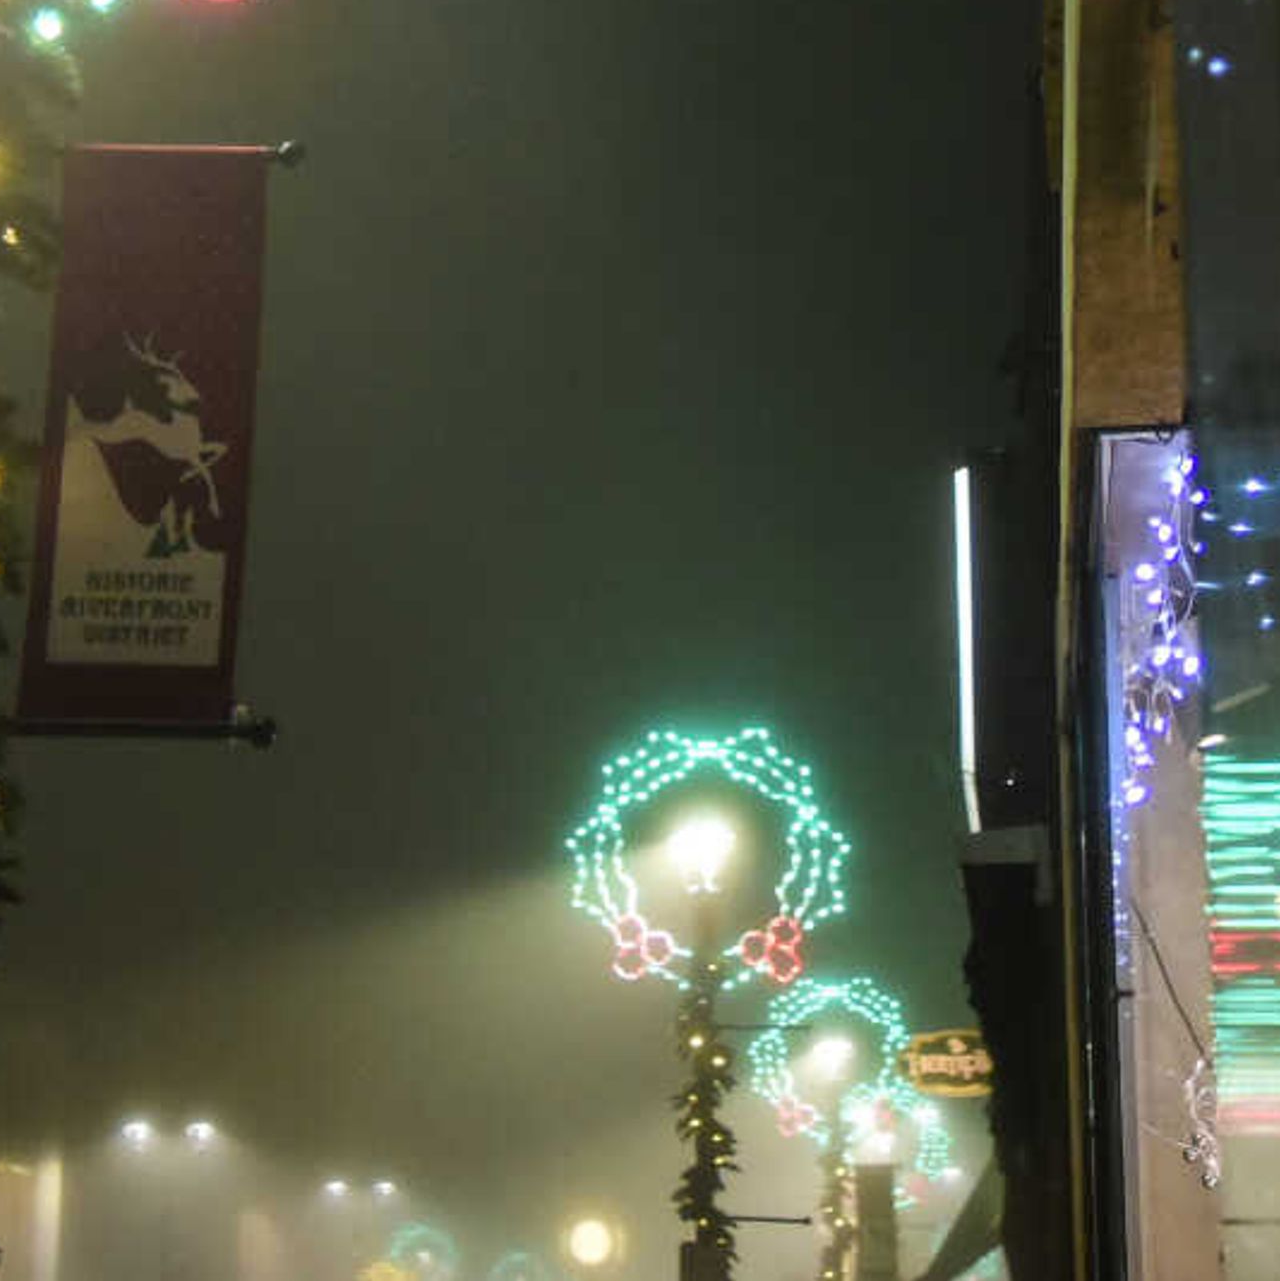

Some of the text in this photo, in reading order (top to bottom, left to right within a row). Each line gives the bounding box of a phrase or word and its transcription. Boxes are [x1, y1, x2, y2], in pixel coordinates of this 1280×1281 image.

[85, 571, 193, 593] HISTORIC
[60, 596, 212, 619] RIVERFRONT
[83, 624, 189, 645] DISTRICT
